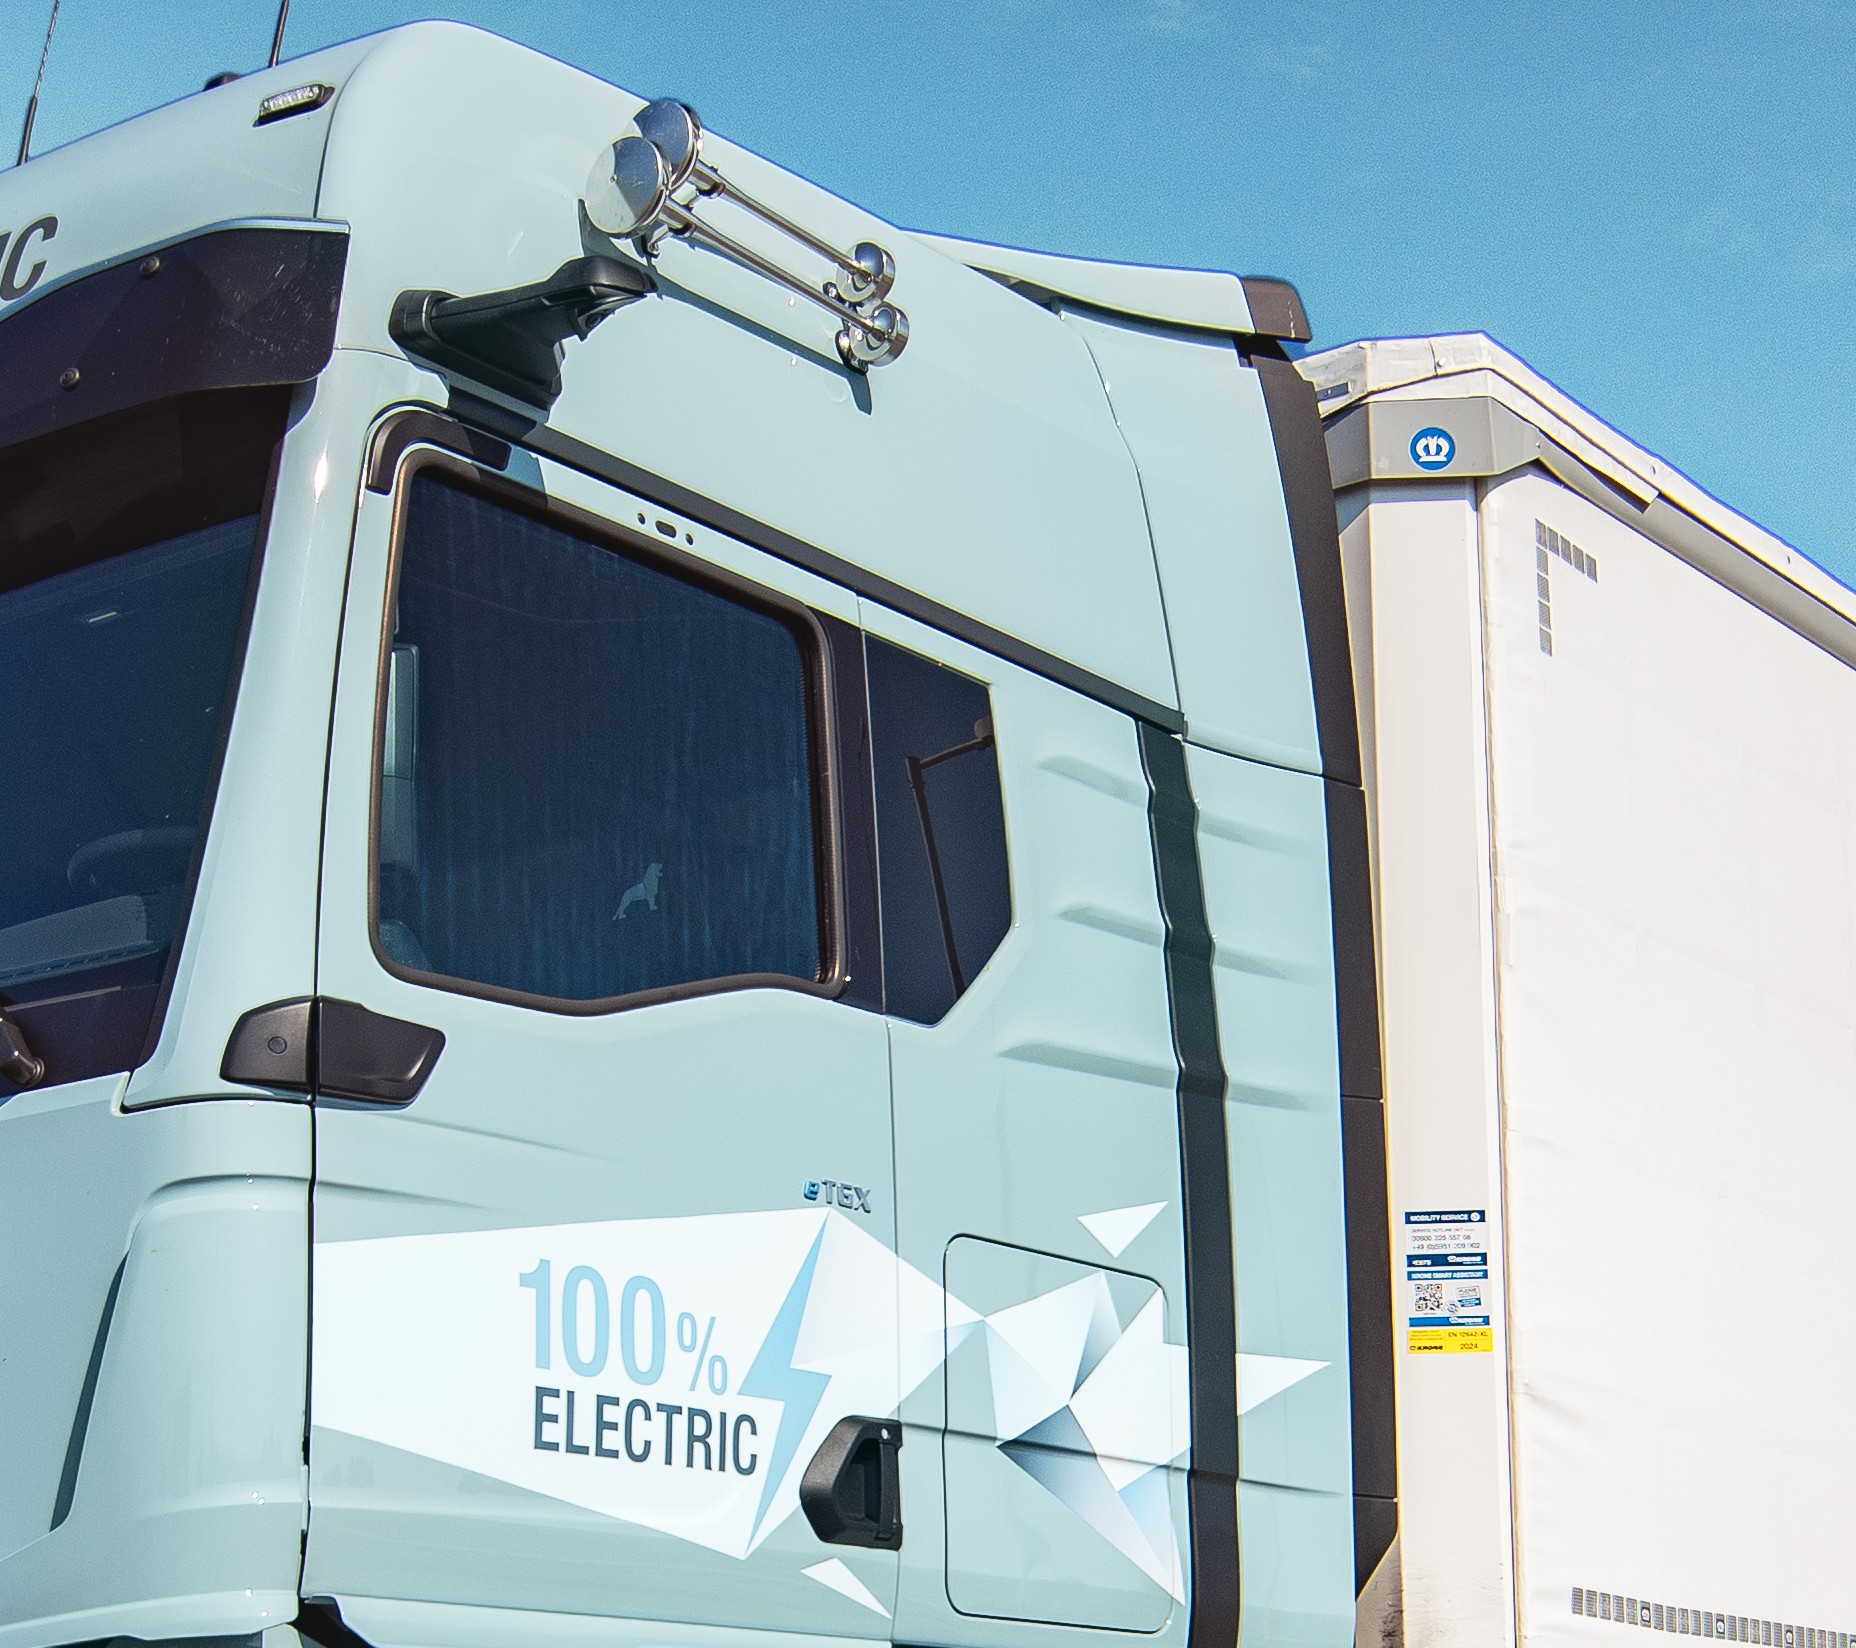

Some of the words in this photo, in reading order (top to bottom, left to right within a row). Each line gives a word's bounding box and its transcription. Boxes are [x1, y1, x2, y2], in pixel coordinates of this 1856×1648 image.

[803, 1179, 872, 1214] eTGX
[519, 1258, 728, 1396] 100%
[534, 1385, 758, 1476] ELECTRIC
